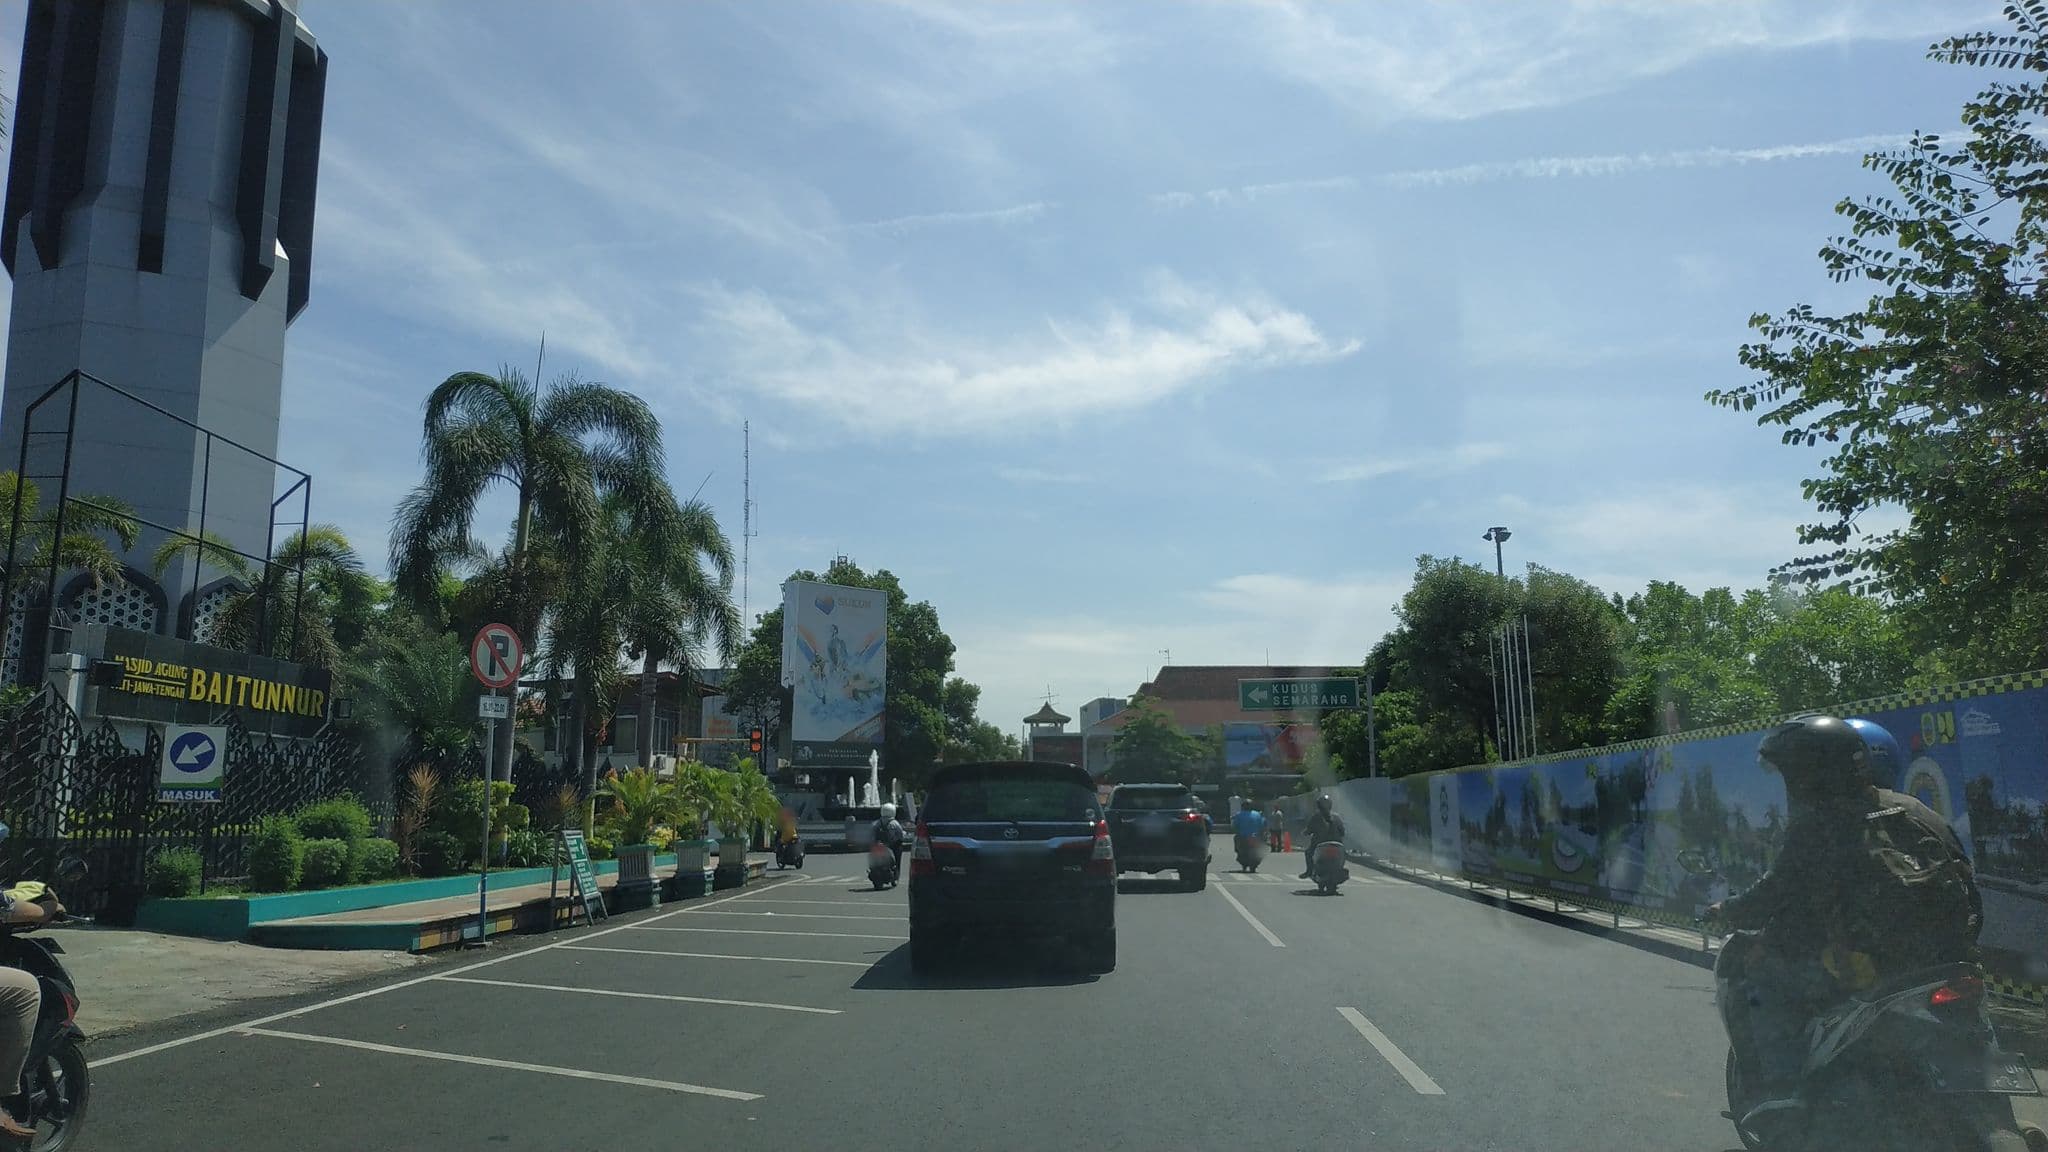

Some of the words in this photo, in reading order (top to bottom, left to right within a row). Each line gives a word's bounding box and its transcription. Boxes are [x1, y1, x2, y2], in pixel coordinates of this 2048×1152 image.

[154, 662, 188, 679] AGUNG
[111, 679, 186, 699] TI-JAWA-TENGAH
[189, 668, 324, 718] BAITUNNUR
[1272, 684, 1318, 694] KUDUS
[1273, 695, 1348, 705] SEMARANG
[162, 790, 215, 801] MASUK
